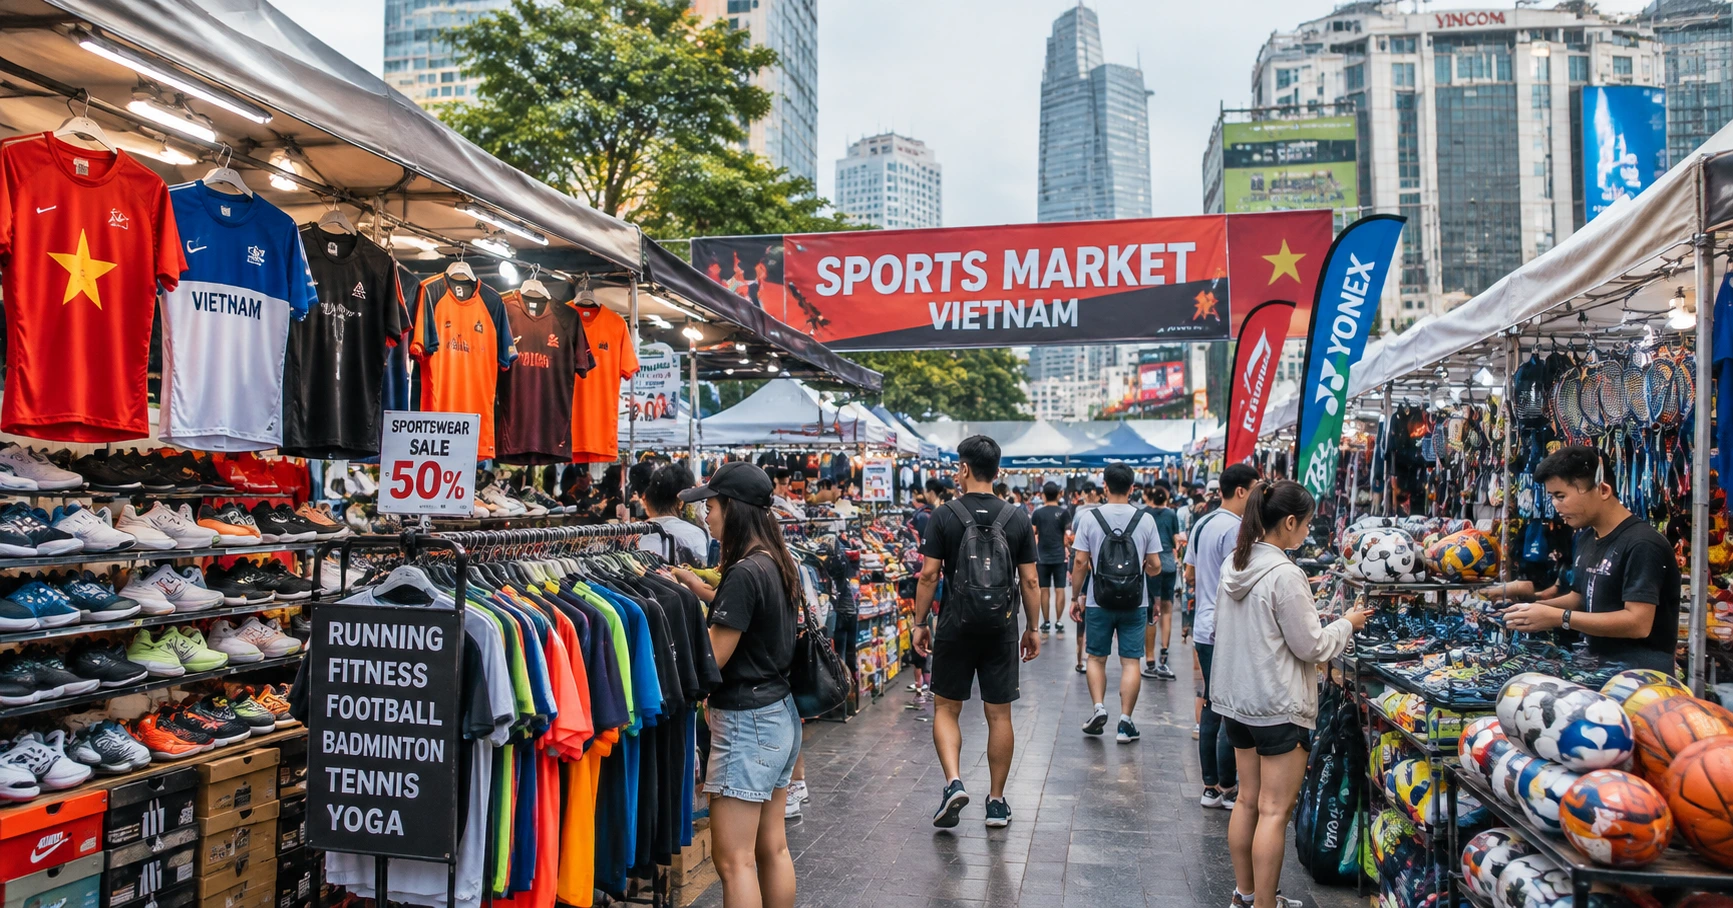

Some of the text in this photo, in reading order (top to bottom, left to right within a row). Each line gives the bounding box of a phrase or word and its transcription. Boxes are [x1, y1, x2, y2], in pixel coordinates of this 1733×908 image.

[815, 241, 1197, 296] SPORTS MARKET
[191, 291, 262, 320] VIETNAM
[928, 298, 1078, 331] VIETNAM
[1326, 252, 1376, 356] YONEX
[391, 420, 470, 435] SPORTSWEAR
[409, 439, 450, 456] SALE
[390, 460, 465, 500] 50%
[328, 621, 443, 651] RUNNING
[328, 657, 428, 688] FITNESS
[326, 694, 443, 726] FOOTBALL
[322, 730, 445, 763] BADMINTON
[325, 767, 420, 799] TENNIS
[326, 804, 404, 836] YOGA
